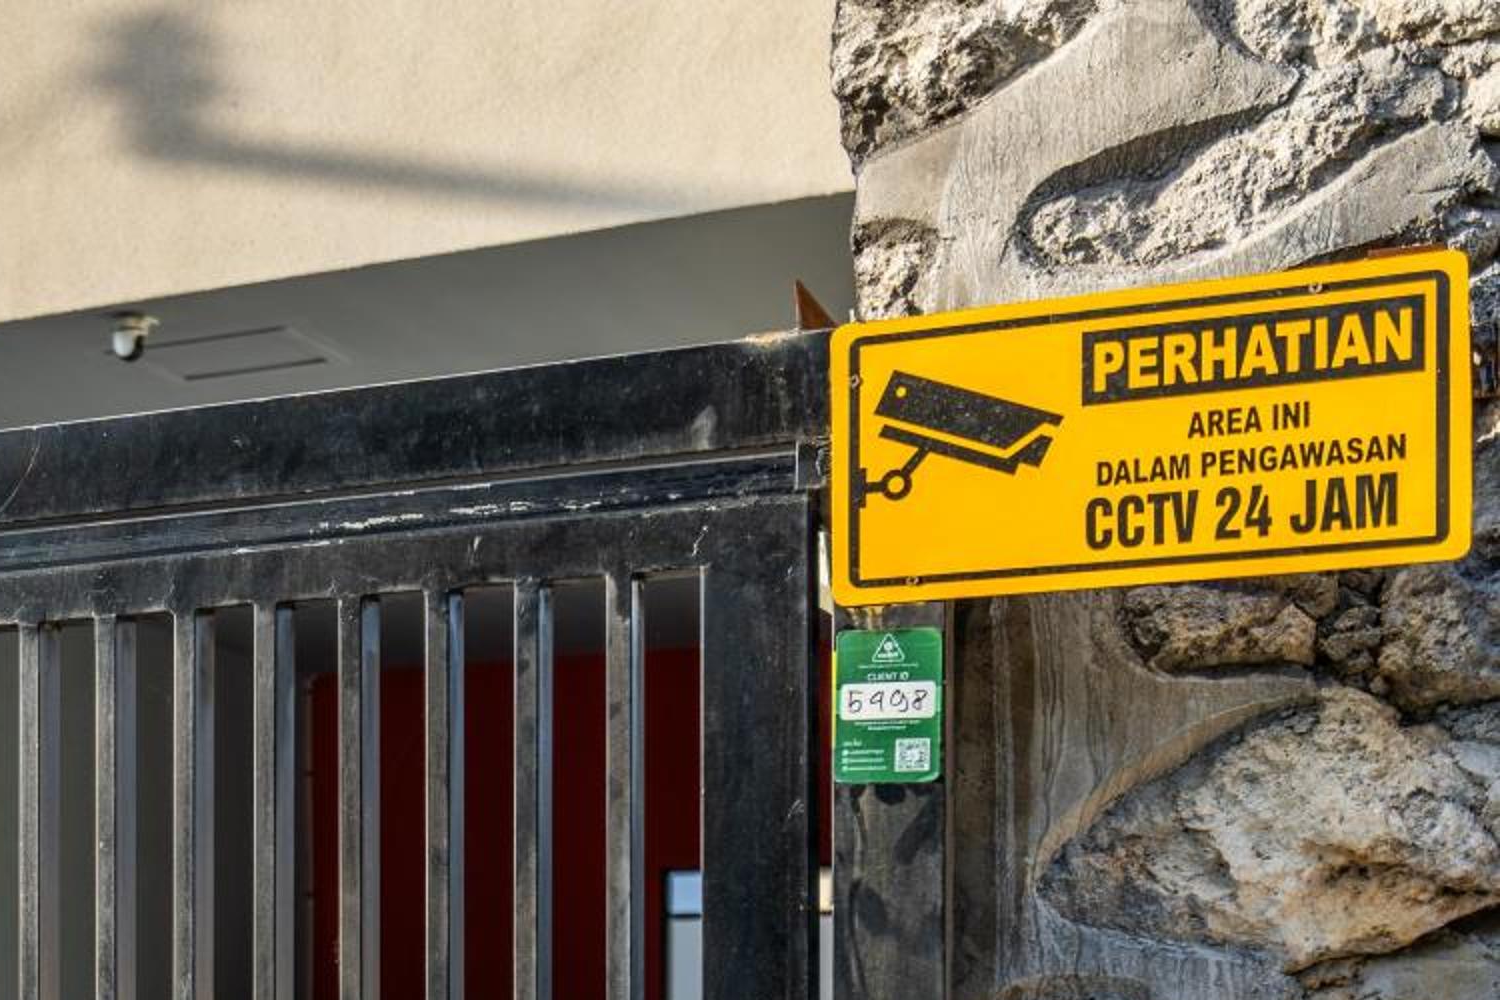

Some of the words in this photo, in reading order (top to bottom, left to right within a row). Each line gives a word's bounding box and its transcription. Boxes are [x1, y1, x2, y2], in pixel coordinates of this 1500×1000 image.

[1092, 306, 1412, 391] PERHATIAN
[1187, 405, 1263, 438] AREA
[1273, 401, 1311, 431] INI
[1096, 454, 1191, 486] DALAM
[1201, 433, 1407, 478] PENGAWASAN
[1085, 490, 1197, 551] CCTV
[1215, 486, 1272, 540] 24
[1289, 471, 1398, 535] JAM
[867, 672, 897, 682] CLIENT
